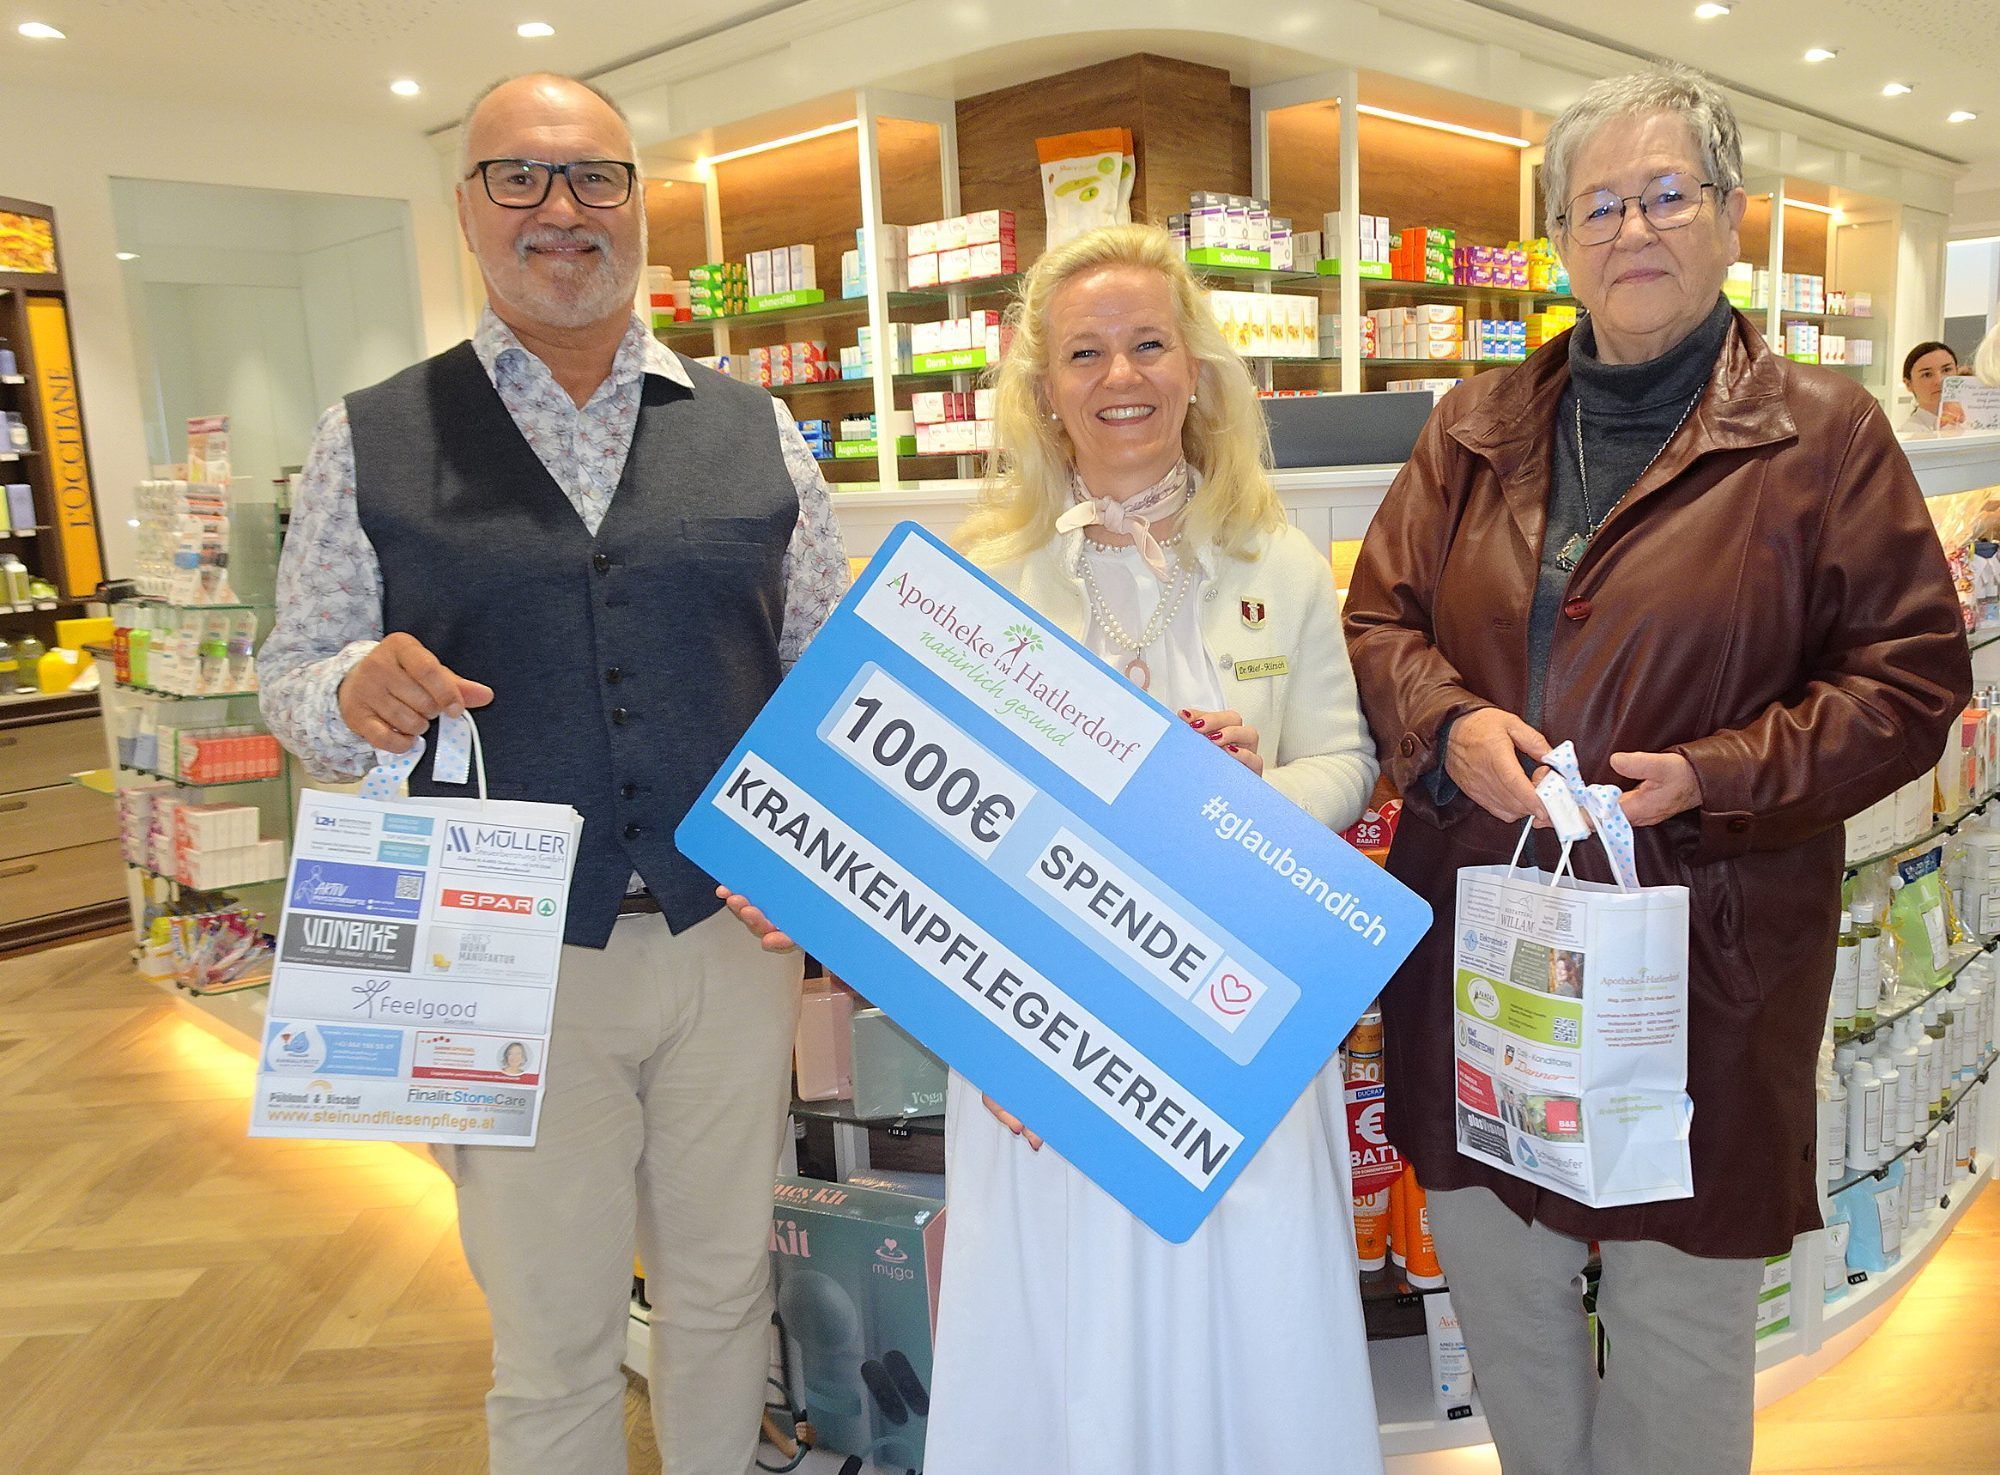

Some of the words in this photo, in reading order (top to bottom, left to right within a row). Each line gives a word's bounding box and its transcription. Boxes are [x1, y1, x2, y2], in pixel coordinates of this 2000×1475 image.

[1220, 252, 1260, 265] Sodbrennen
[925, 357, 947, 369] Darm
[951, 354, 973, 366] Wohl
[837, 444, 859, 456] Augen
[886, 572, 994, 659] Apotheke
[1012, 661, 1142, 764] Hatlerdorf
[994, 696, 1075, 748] gesund
[850, 694, 1018, 844] 1000€
[1357, 823, 1381, 838] 3€
[1200, 794, 1389, 948] #glaubandich
[459, 893, 531, 912] SPAR
[1040, 842, 1209, 985] SPENDE
[1500, 914, 1536, 934] WILLAM
[303, 917, 400, 953] VONBIKE
[725, 767, 1230, 1176] KRANKENPFLEGEVEREIN
[1351, 1062, 1379, 1081] 50
[911, 1091, 944, 1106] Yoga
[1357, 1088, 1383, 1098] DUCRAY
[267, 1110, 495, 1131] www.steinundfliesenpflege.at
[1355, 1102, 1389, 1145] €
[1350, 1145, 1399, 1167] BATT
[768, 1219, 812, 1258] Kit
[872, 1262, 914, 1281] myga
